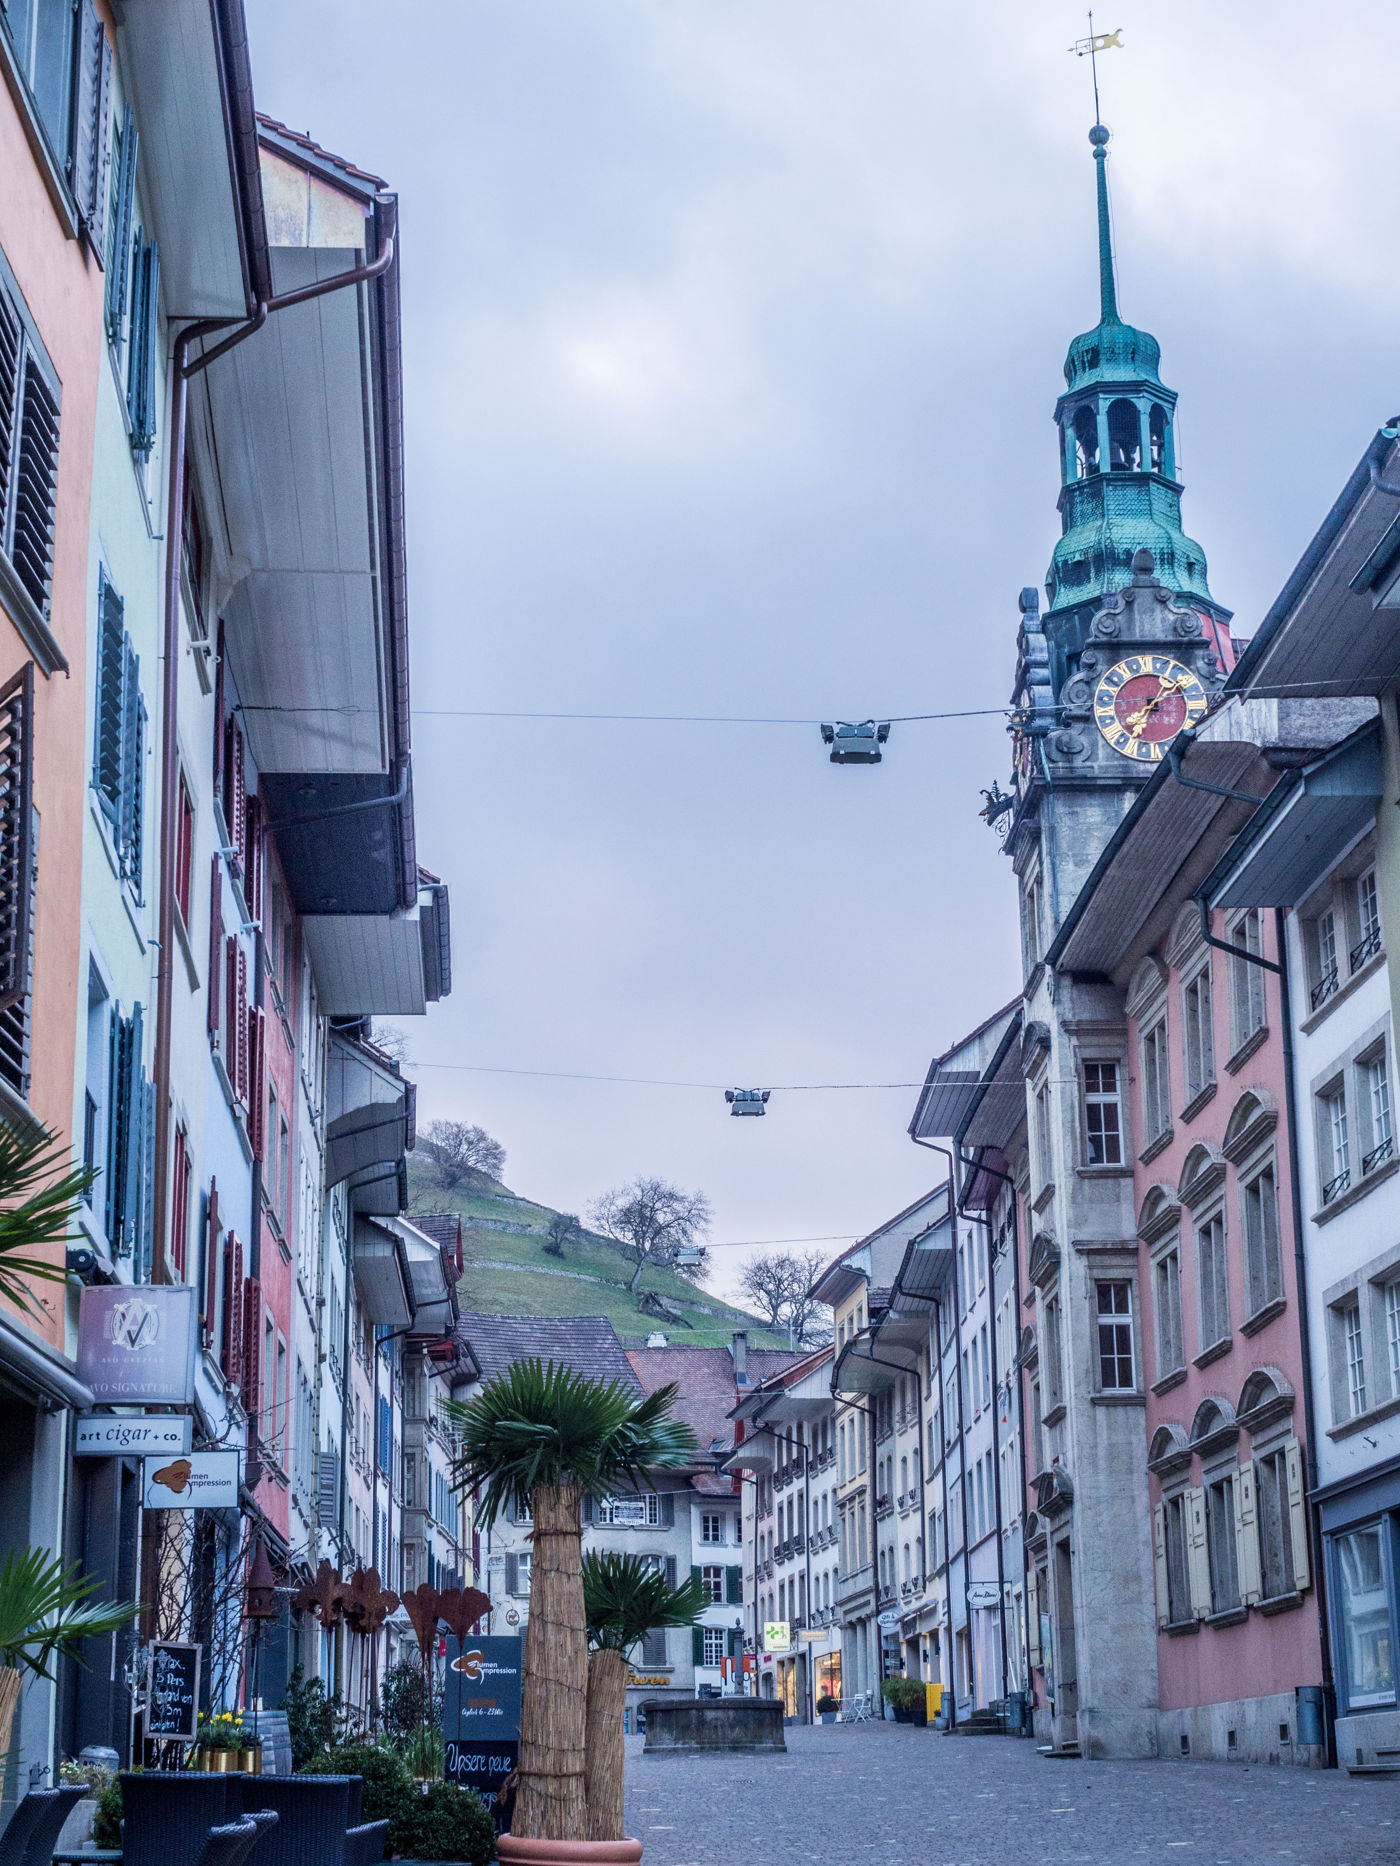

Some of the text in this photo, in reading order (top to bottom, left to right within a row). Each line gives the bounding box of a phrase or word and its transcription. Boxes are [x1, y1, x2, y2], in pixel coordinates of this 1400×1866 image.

[112, 1384, 176, 1393] SIGNATURE
[80, 1432, 101, 1441] art
[106, 1424, 152, 1446] cigar
[164, 1433, 181, 1441] co.
